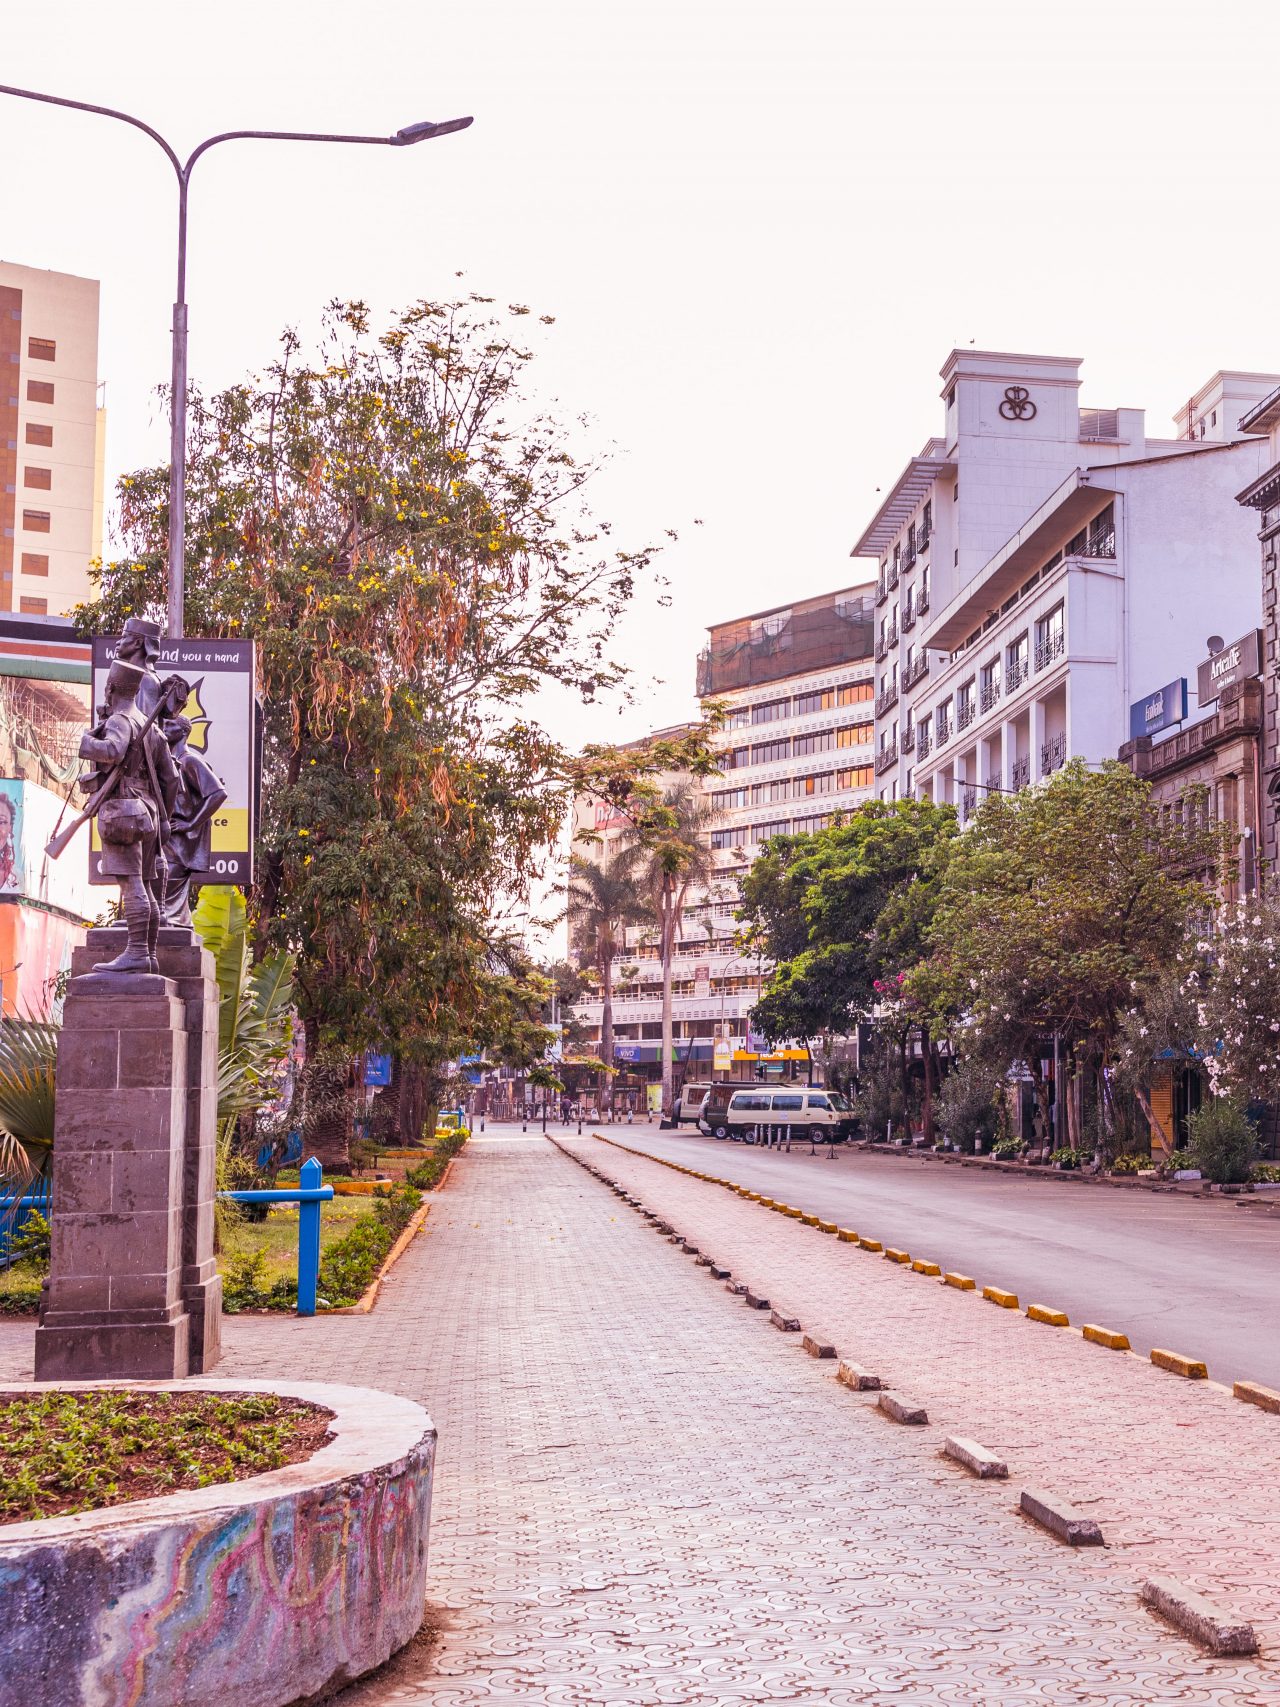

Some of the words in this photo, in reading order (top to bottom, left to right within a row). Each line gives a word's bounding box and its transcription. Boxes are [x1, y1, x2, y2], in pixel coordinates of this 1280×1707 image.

[182, 653, 201, 661] you
[205, 654, 211, 662] a
[215, 653, 239, 663] hand
[620, 1049, 635, 1057] vivo
